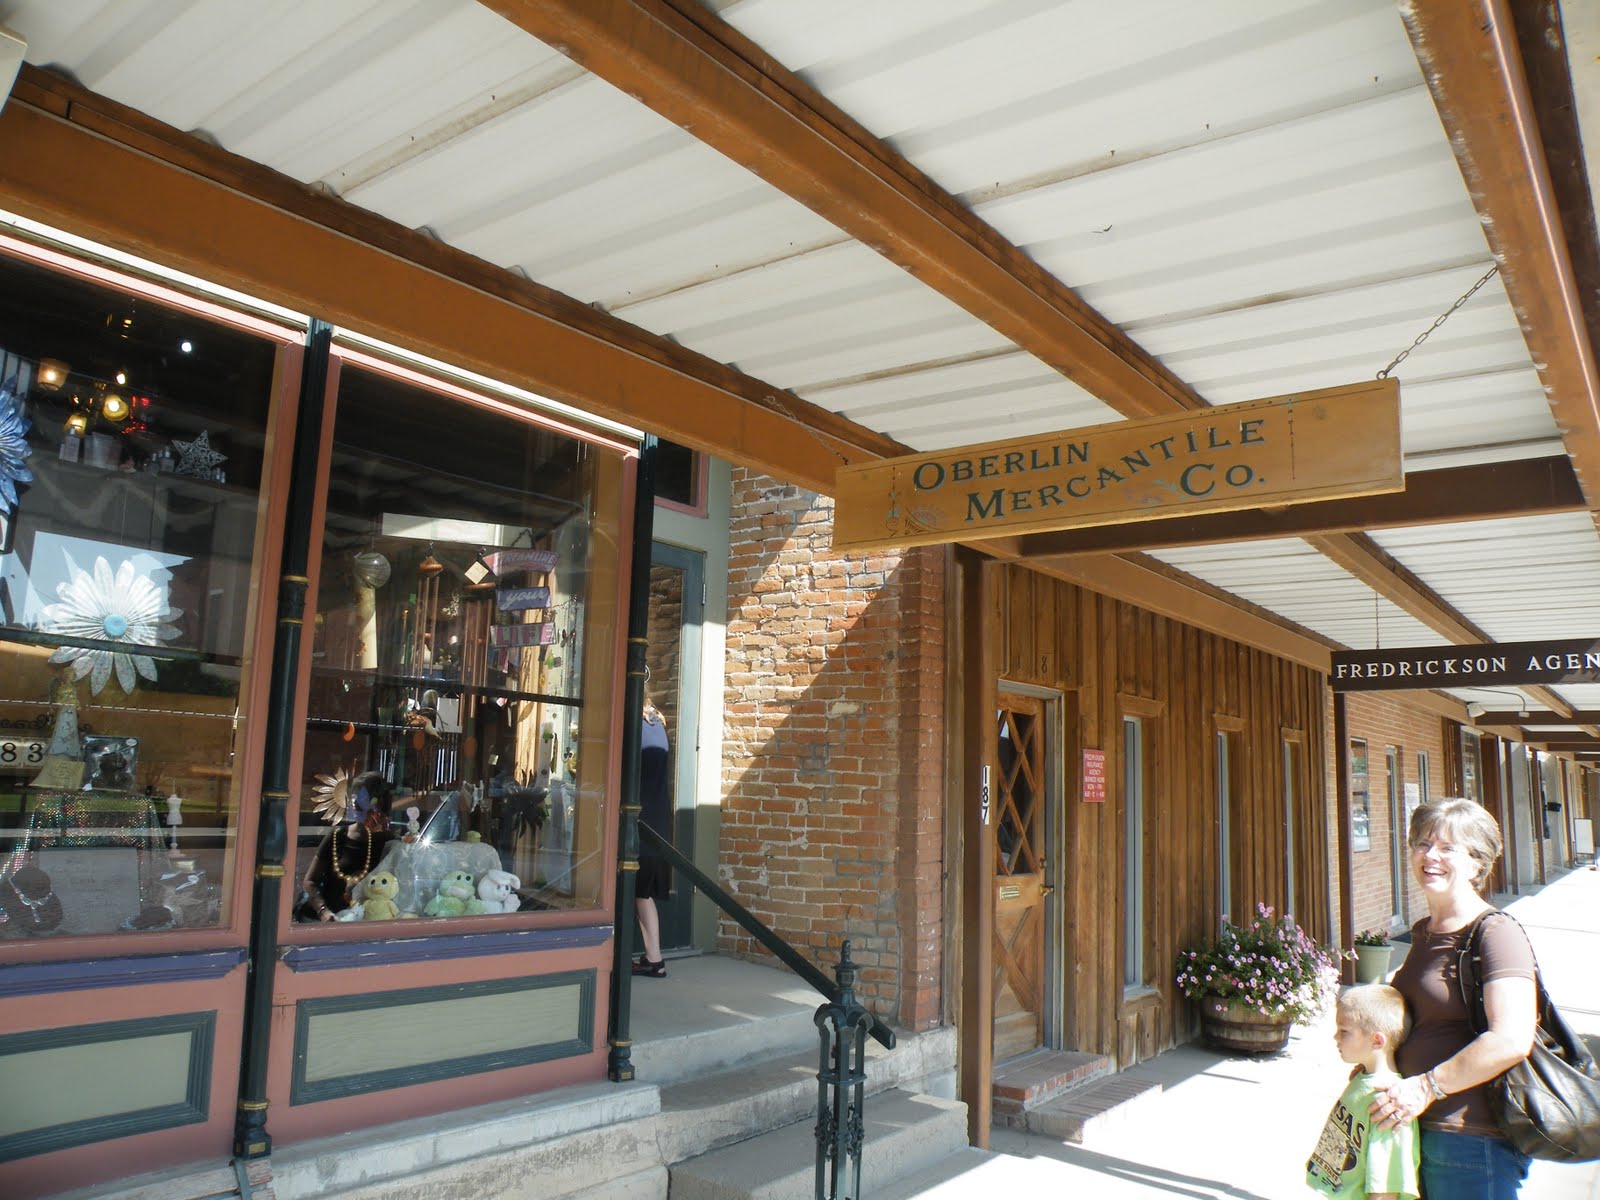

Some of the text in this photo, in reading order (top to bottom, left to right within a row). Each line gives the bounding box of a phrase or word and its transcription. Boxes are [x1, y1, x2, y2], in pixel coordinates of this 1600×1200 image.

[913, 441, 1090, 491] OBERLIN
[964, 418, 1265, 523] MERCANTILE
[500, 589, 548, 611] your
[496, 624, 554, 645] LIFE
[1336, 652, 1600, 679] FREDRICKSON AGEN
